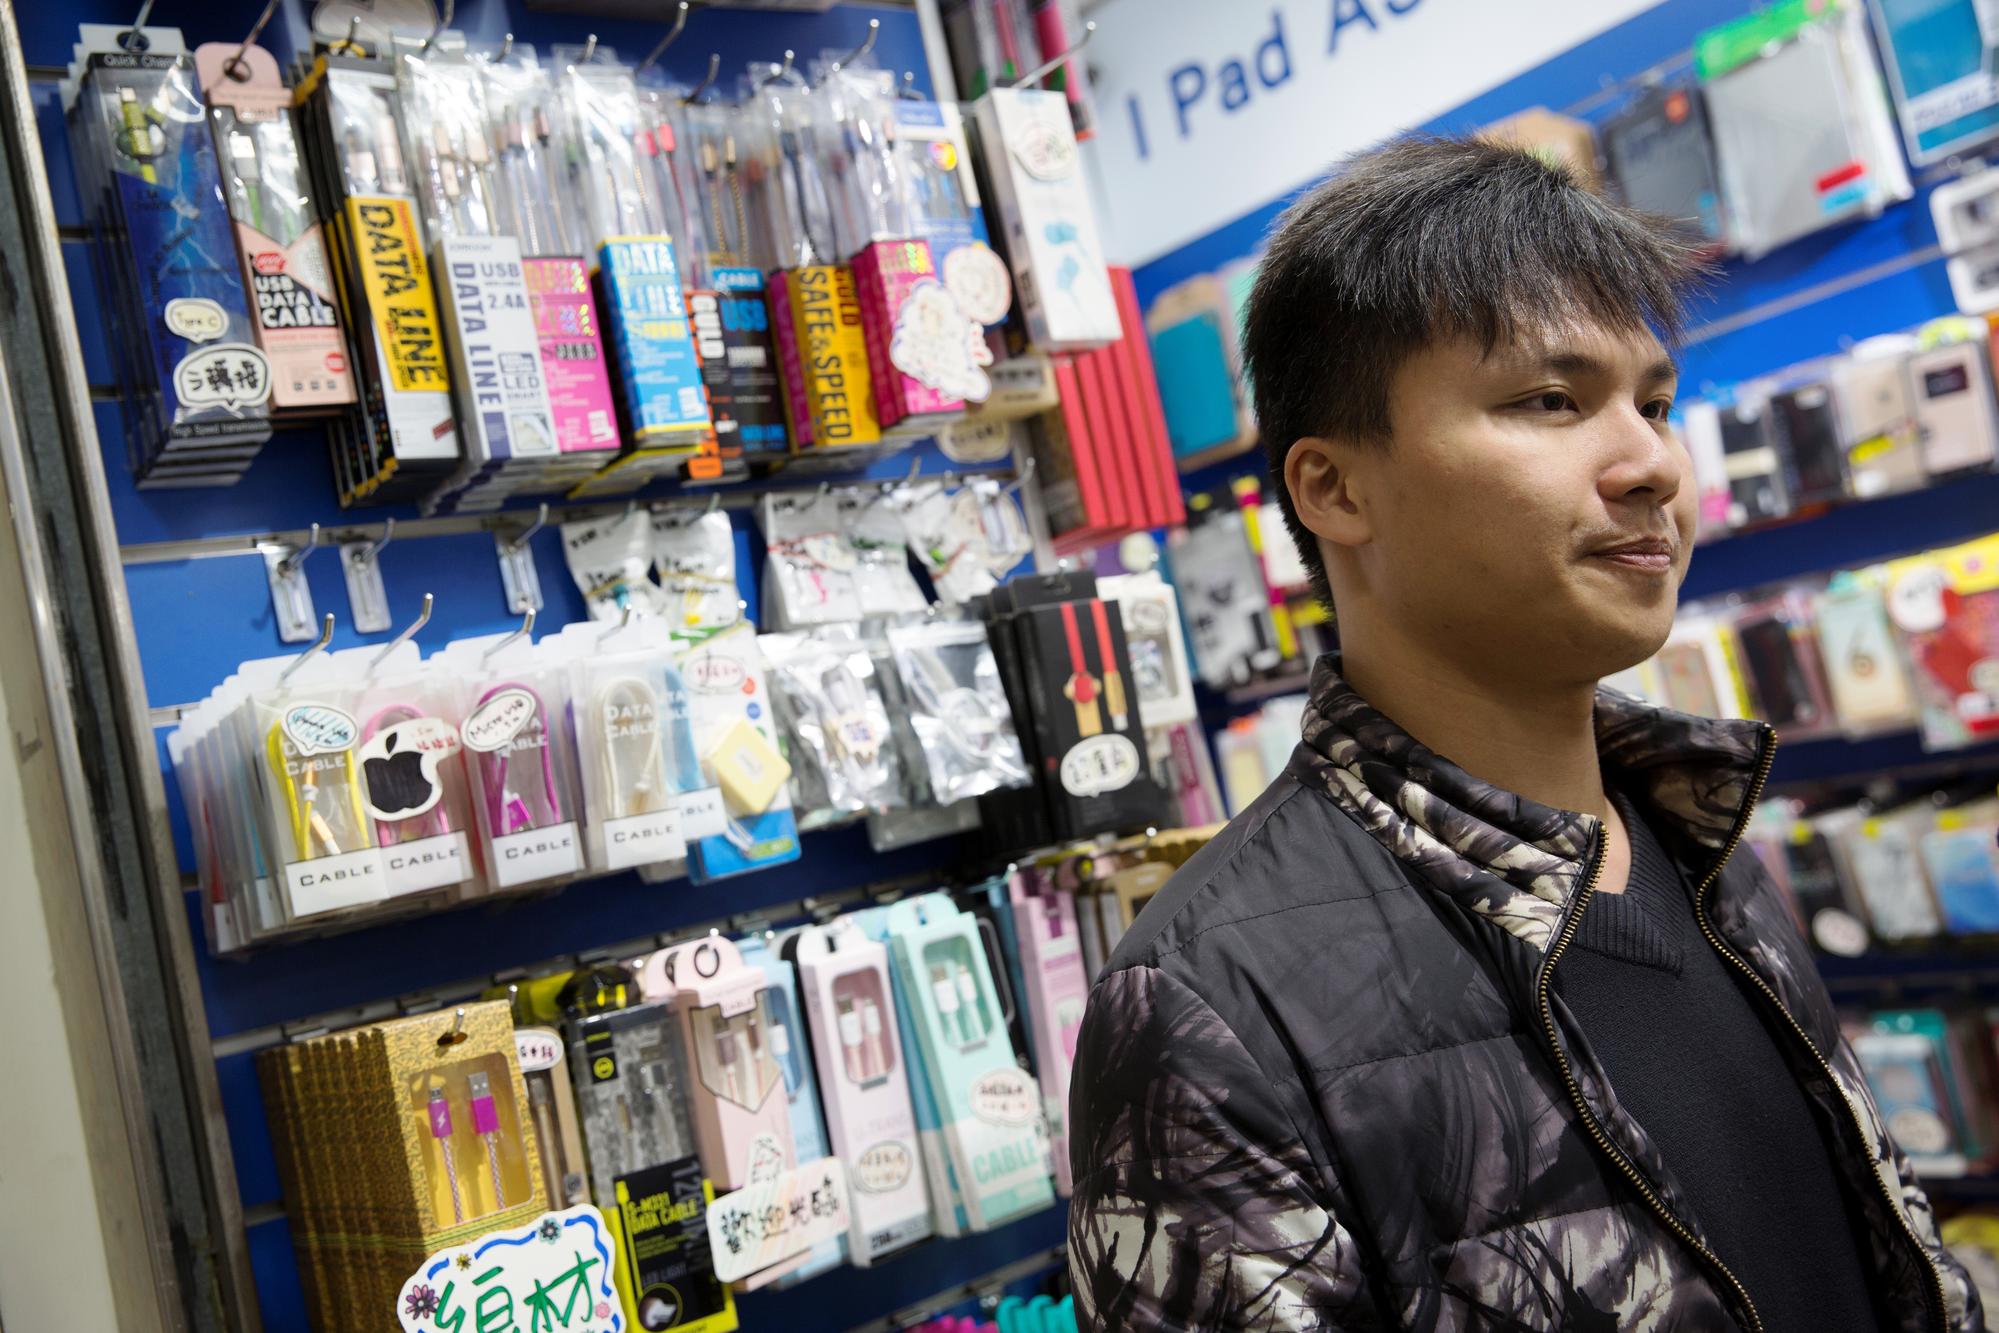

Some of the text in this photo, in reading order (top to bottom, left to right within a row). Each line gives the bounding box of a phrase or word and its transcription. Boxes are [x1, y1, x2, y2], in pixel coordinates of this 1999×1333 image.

[104, 55, 138, 67] Quick
[1126, 93, 1150, 161] I
[1168, 7, 1293, 138] Pad
[1326, 0, 1427, 54] A
[359, 205, 418, 297] DATA
[481, 262, 521, 279] USB
[256, 275, 294, 293] USB
[258, 291, 310, 309] DATA
[452, 262, 488, 334] DATA
[799, 270, 836, 336] SAFE
[261, 305, 336, 328] CABLE
[468, 345, 502, 405] LINE
[504, 376, 541, 390] LED
[814, 355, 853, 439] SPEED
[608, 703, 653, 719] DATA
[509, 733, 548, 751] ABLE
[608, 724, 656, 739] CABLE
[286, 755, 346, 776] CABLE
[681, 802, 715, 818] BLE
[613, 825, 674, 843] CABLE
[389, 847, 462, 870] CABLE
[505, 837, 572, 860] CABLE
[300, 863, 375, 887] CABLE
[973, 1136, 1039, 1184] CABLE
